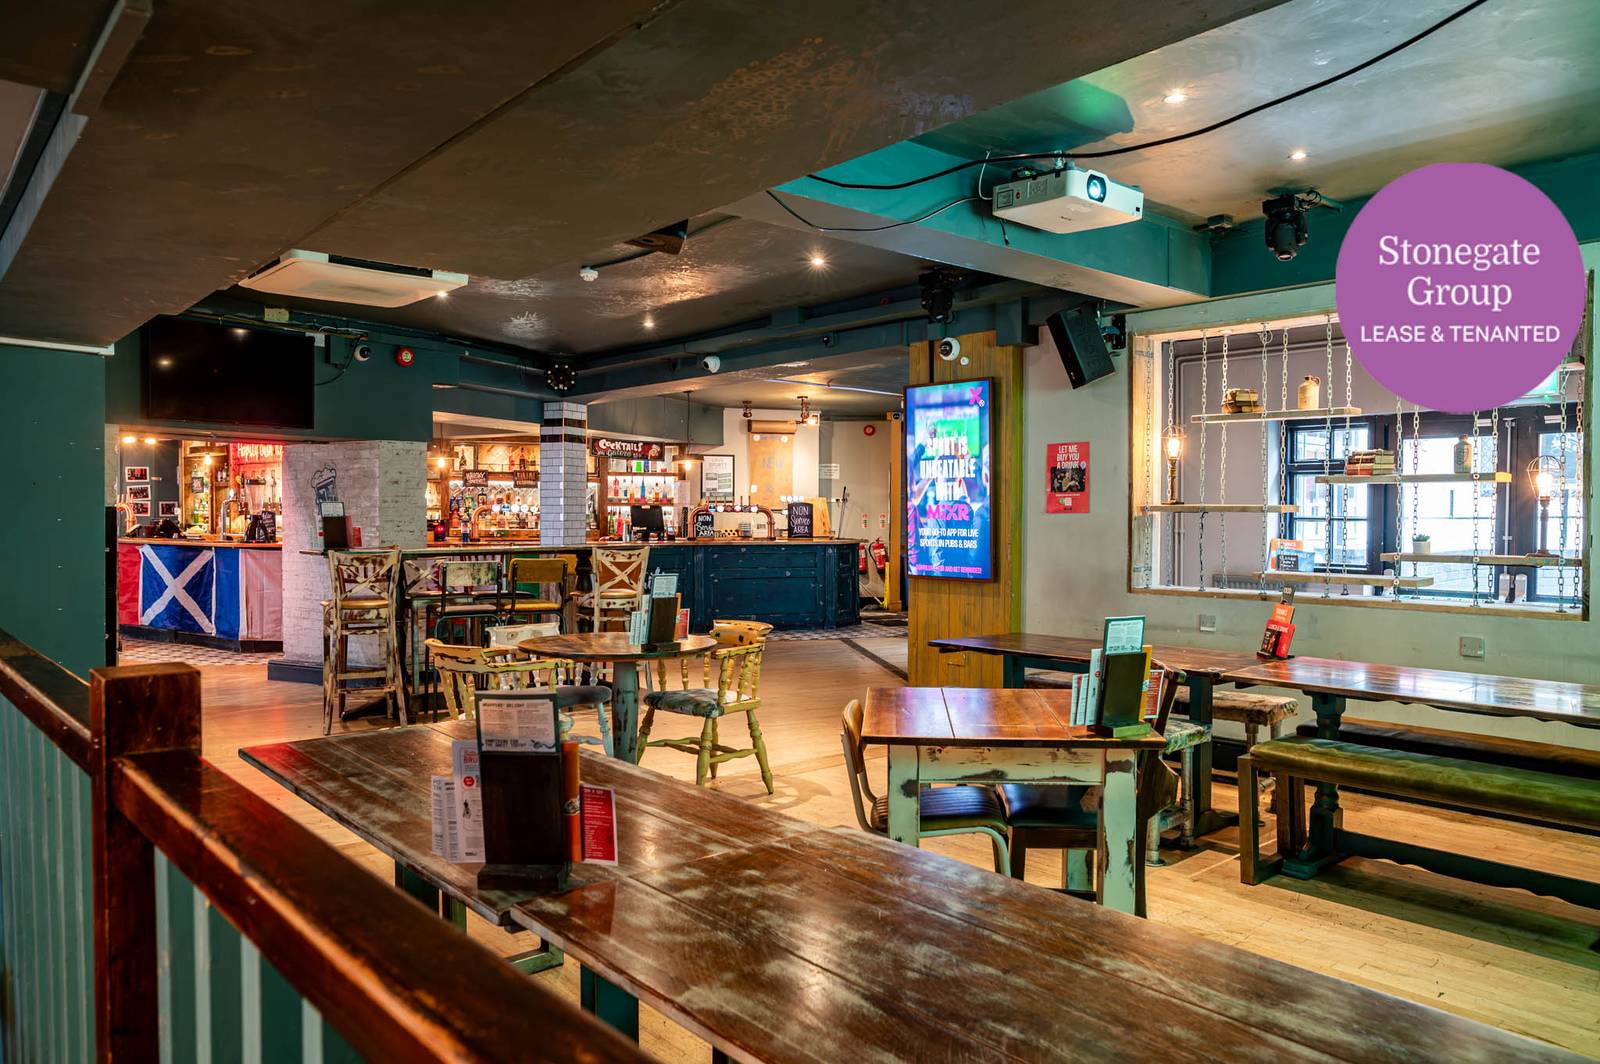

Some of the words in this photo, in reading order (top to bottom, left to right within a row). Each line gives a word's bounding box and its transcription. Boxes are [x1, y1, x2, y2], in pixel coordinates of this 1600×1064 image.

[598, 438, 644, 452] COCKTAILS
[926, 436, 956, 457] SPORT
[958, 435, 968, 456] IS
[1058, 445, 1068, 454] LET
[1069, 444, 1078, 453] ME
[1056, 453, 1068, 462] BUY
[1069, 453, 1080, 461] YOU
[919, 458, 976, 480] UNBEATABLE
[1062, 461, 1079, 470] DRINK
[935, 480, 962, 502] WITH
[792, 506, 809, 516] NON
[698, 514, 712, 522] NON
[790, 514, 811, 527] Service
[793, 525, 809, 534] AREA
[947, 528, 958, 537] APP
[958, 528, 968, 537] FOR
[968, 529, 979, 538] LIVE
[920, 538, 939, 548] SPORTS
[939, 539, 945, 548] IN
[945, 539, 959, 548] PUBS
[964, 540, 978, 549] BARS
